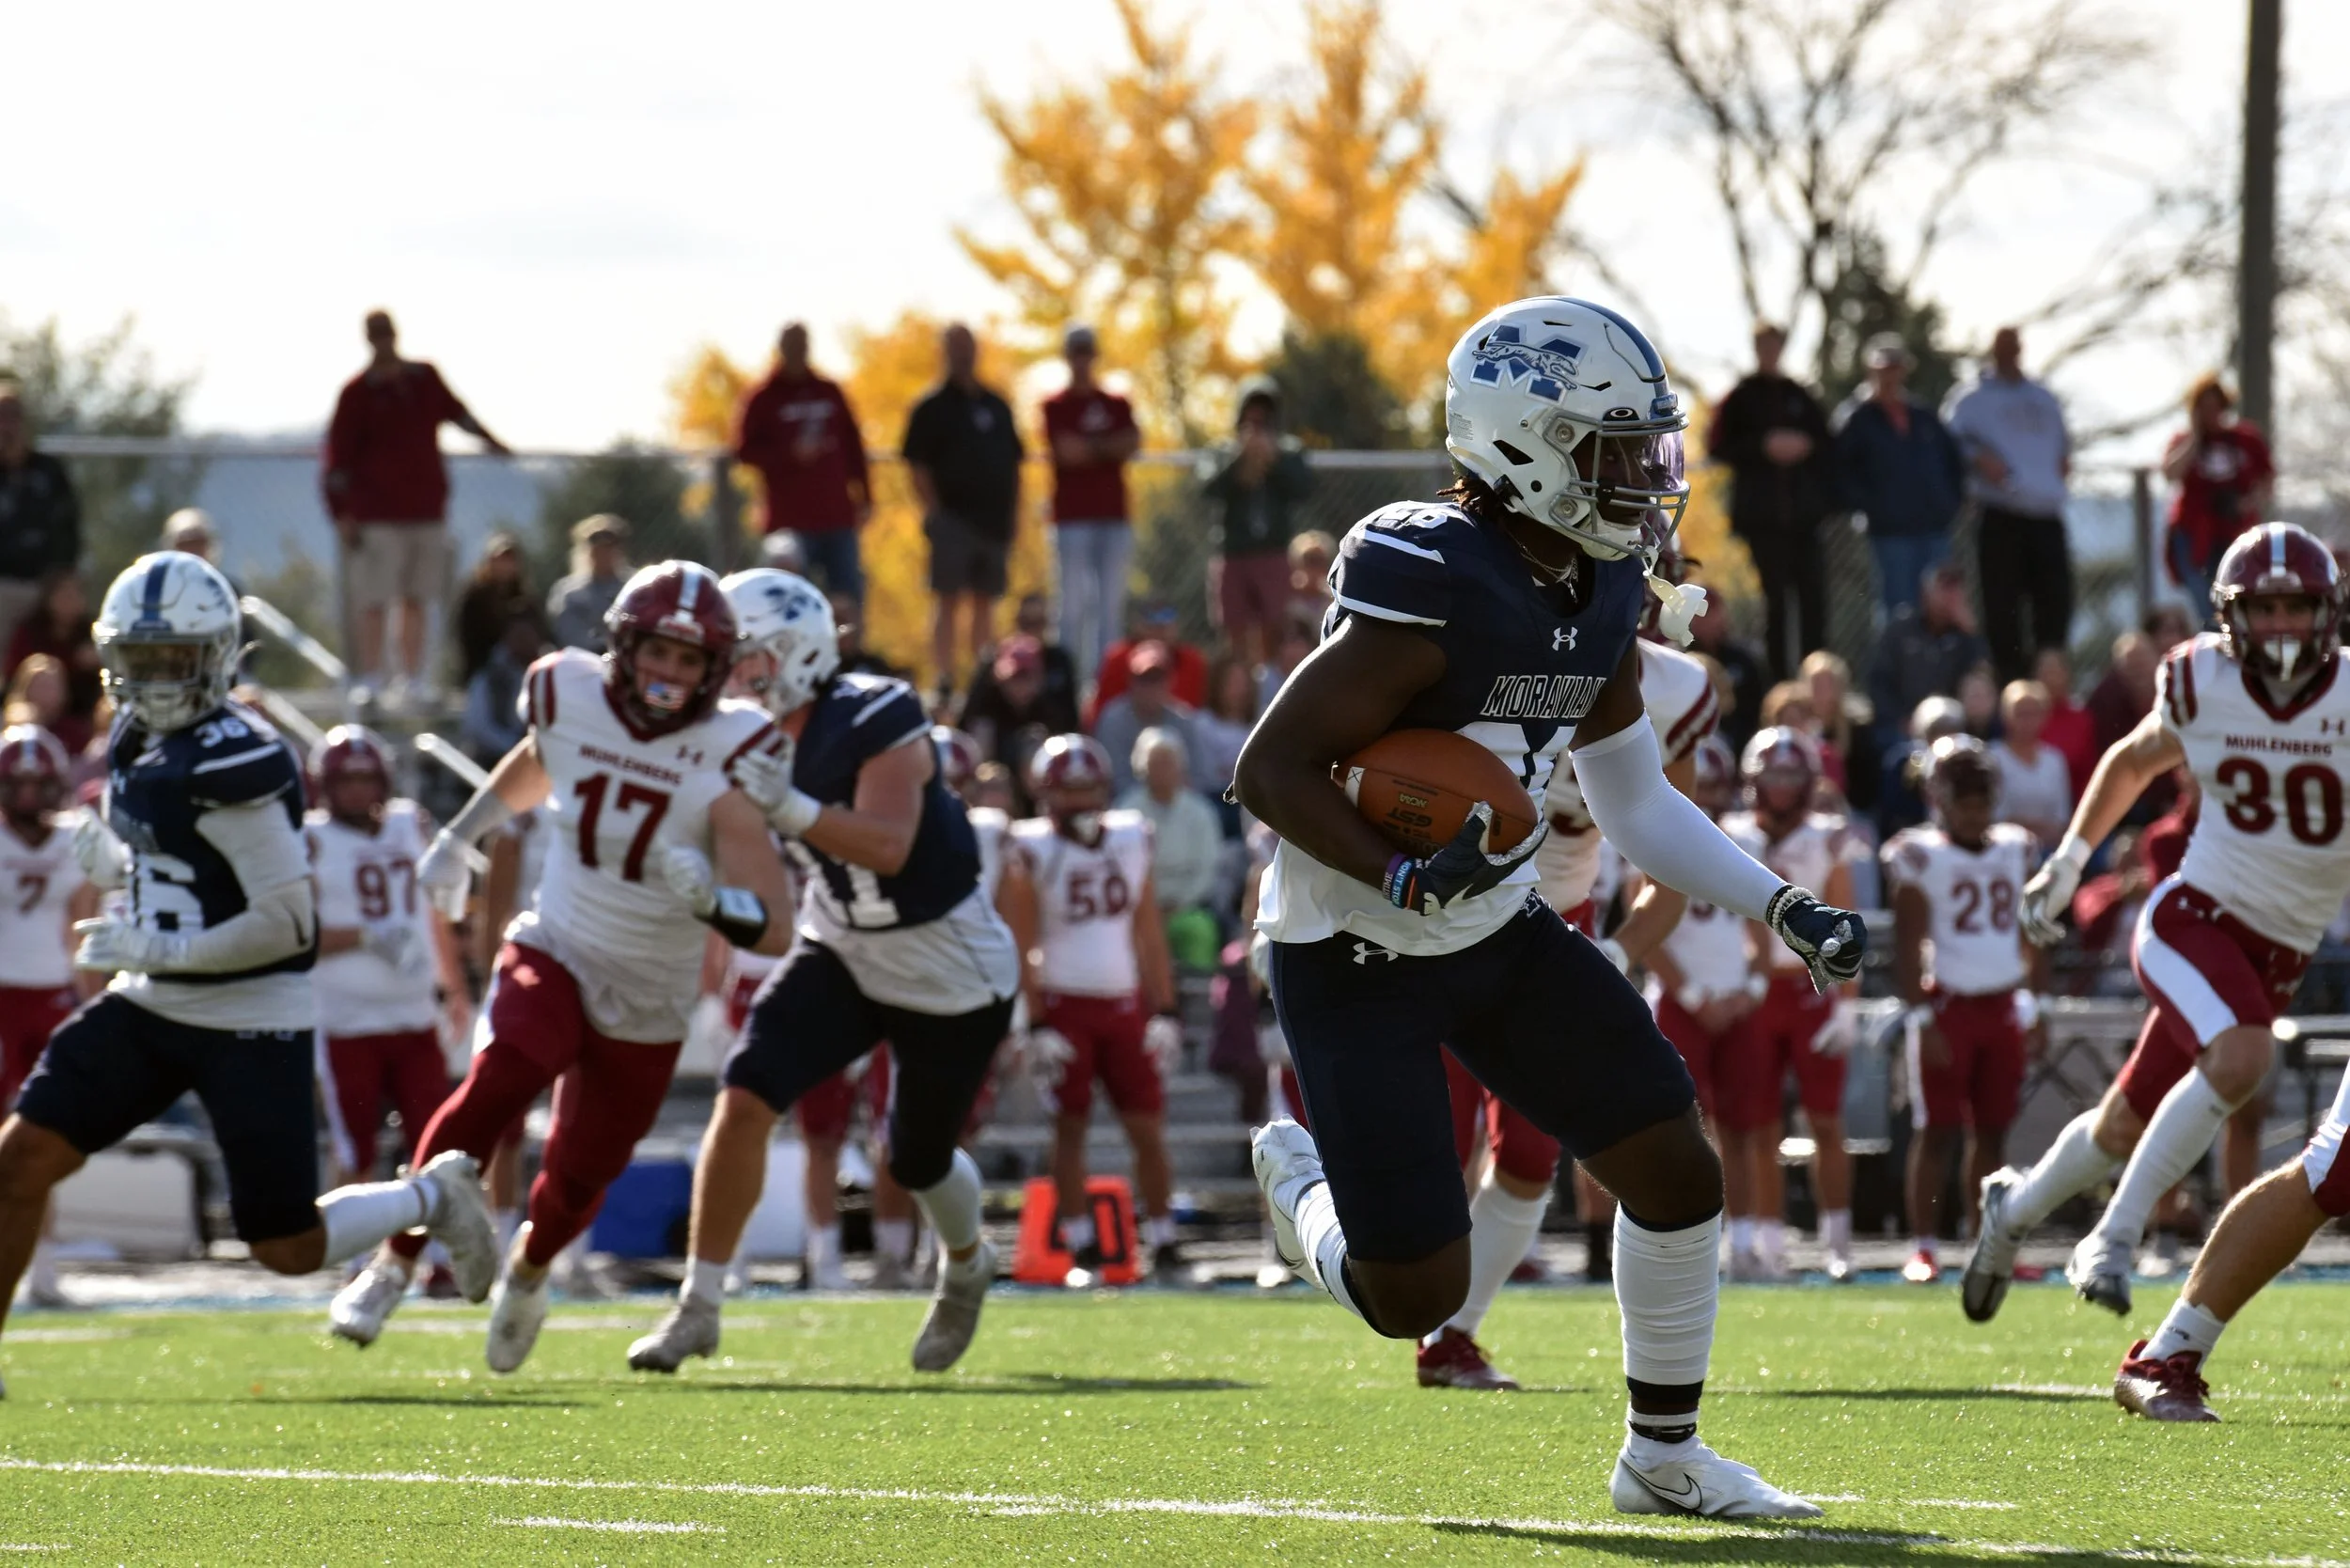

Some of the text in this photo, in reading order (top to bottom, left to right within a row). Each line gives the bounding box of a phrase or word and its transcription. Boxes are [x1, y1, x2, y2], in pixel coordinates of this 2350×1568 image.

[1480, 674, 1607, 719] MORAVIAN
[194, 716, 250, 748] 36
[2225, 734, 2333, 756] MUHLENBERG
[1386, 807, 1433, 827] GST
[1399, 792, 1429, 808] NCAA
[2216, 755, 2345, 846] 30
[572, 771, 674, 884] 17
[17, 870, 49, 916] 7
[354, 857, 416, 920] 97
[1950, 877, 2013, 936] 28
